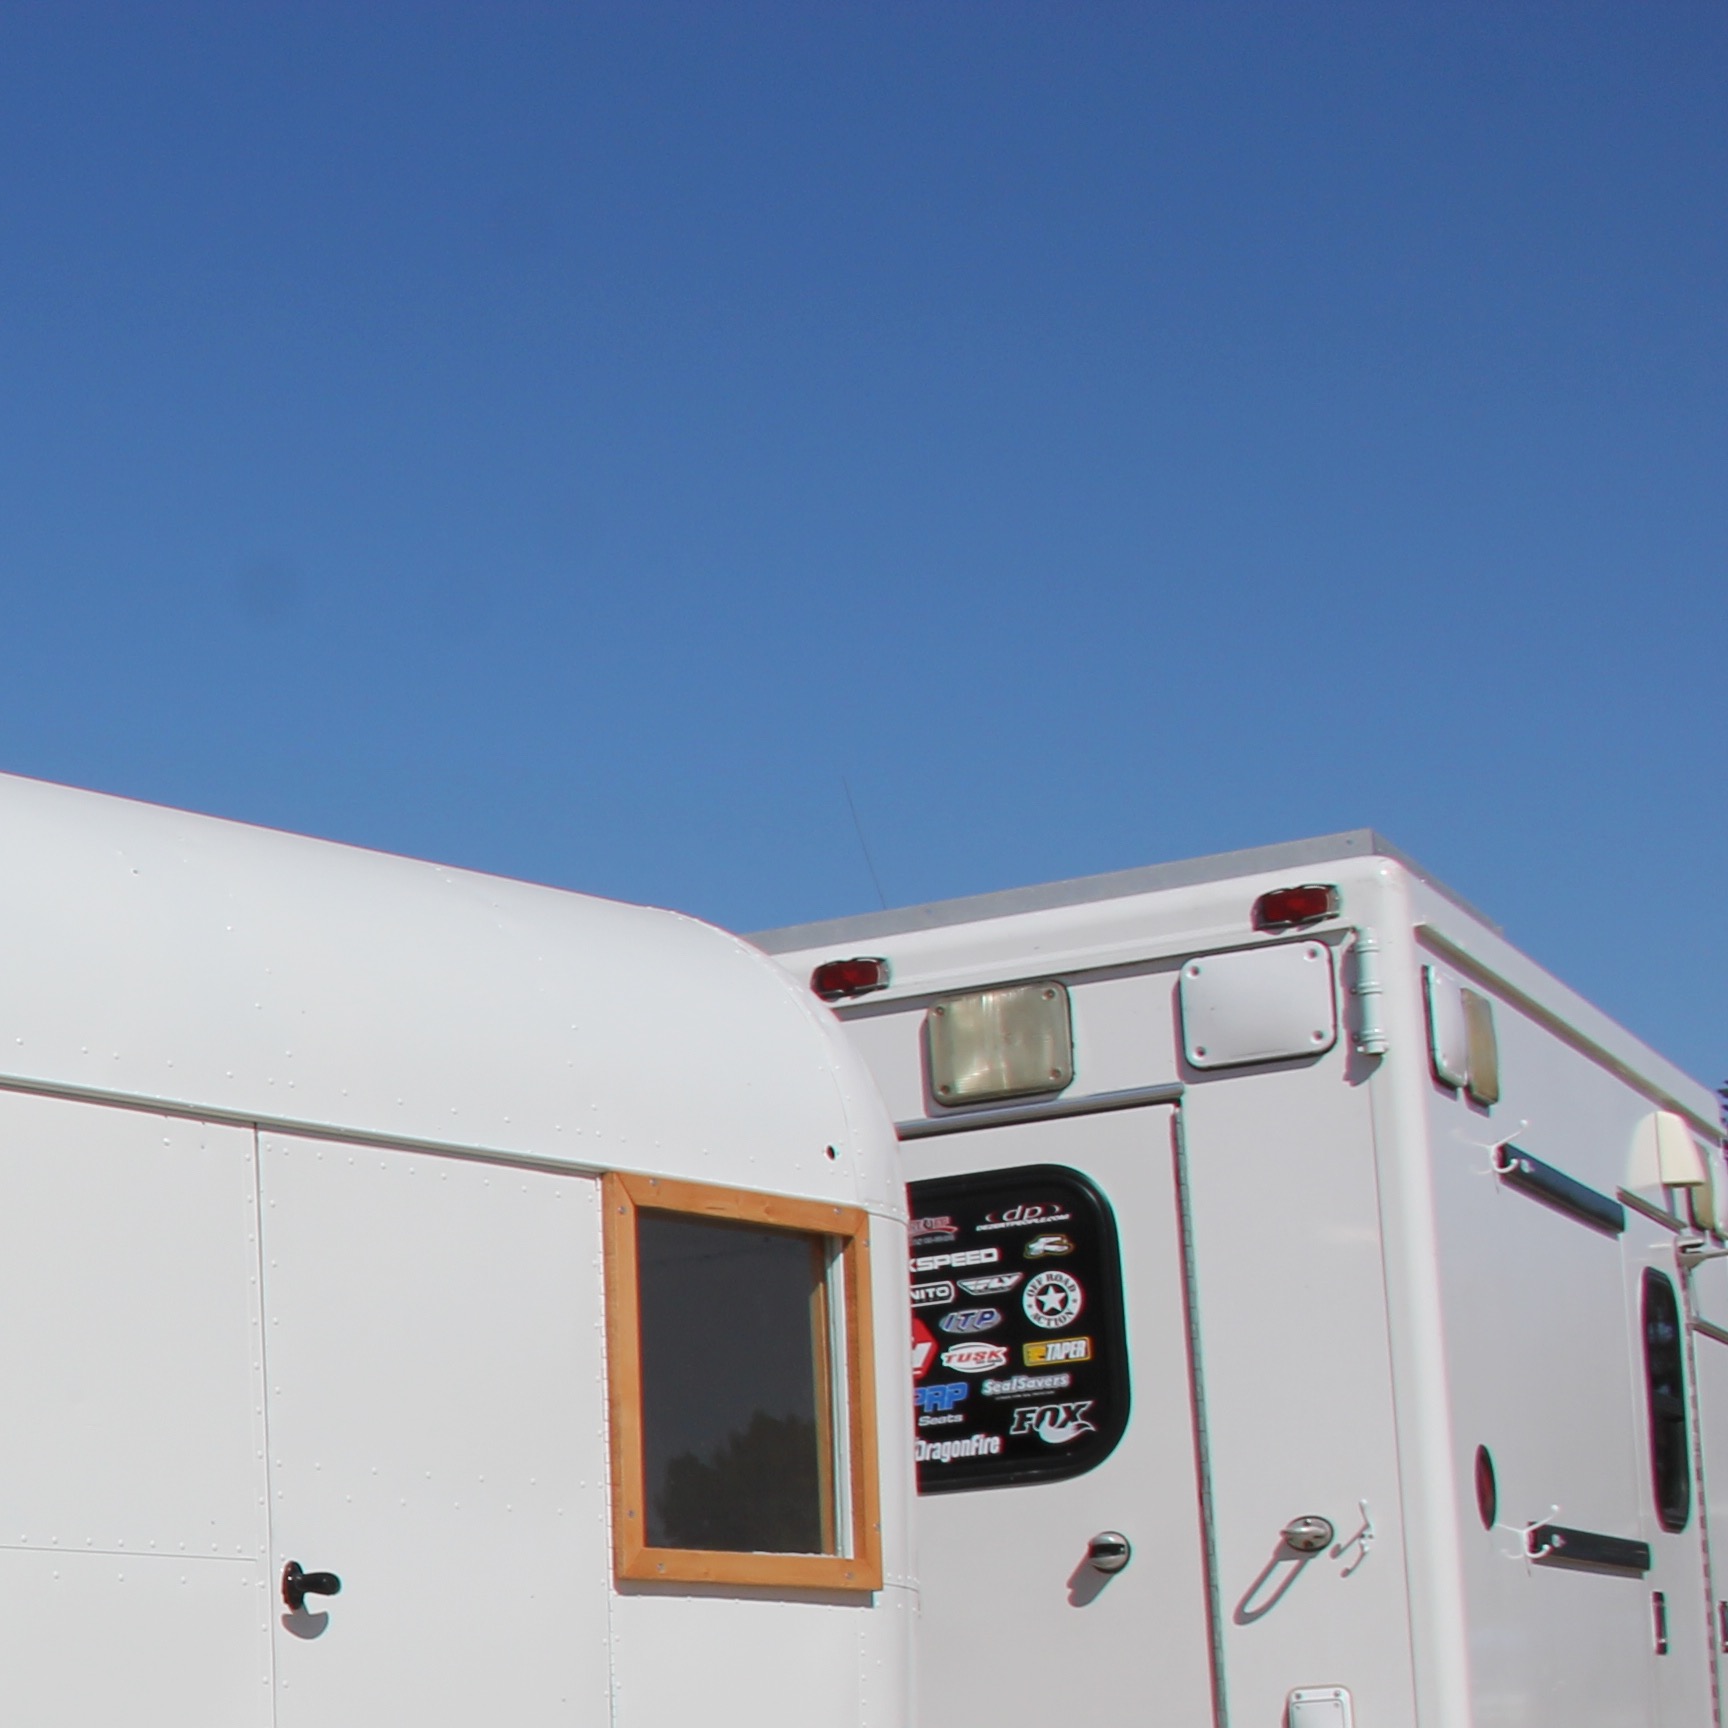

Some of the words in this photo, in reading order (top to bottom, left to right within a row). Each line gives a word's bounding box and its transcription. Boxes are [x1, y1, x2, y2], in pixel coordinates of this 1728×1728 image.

[1046, 1273, 1077, 1292] ROAD
[944, 1310, 996, 1331] ITP
[1032, 1308, 1075, 1327] ACTION
[945, 1351, 1001, 1364] TUSK
[1046, 1340, 1086, 1361] TAPER
[981, 1374, 1070, 1396] SealSavers
[918, 1414, 964, 1426] Seats
[1010, 1401, 1094, 1436] FOX
